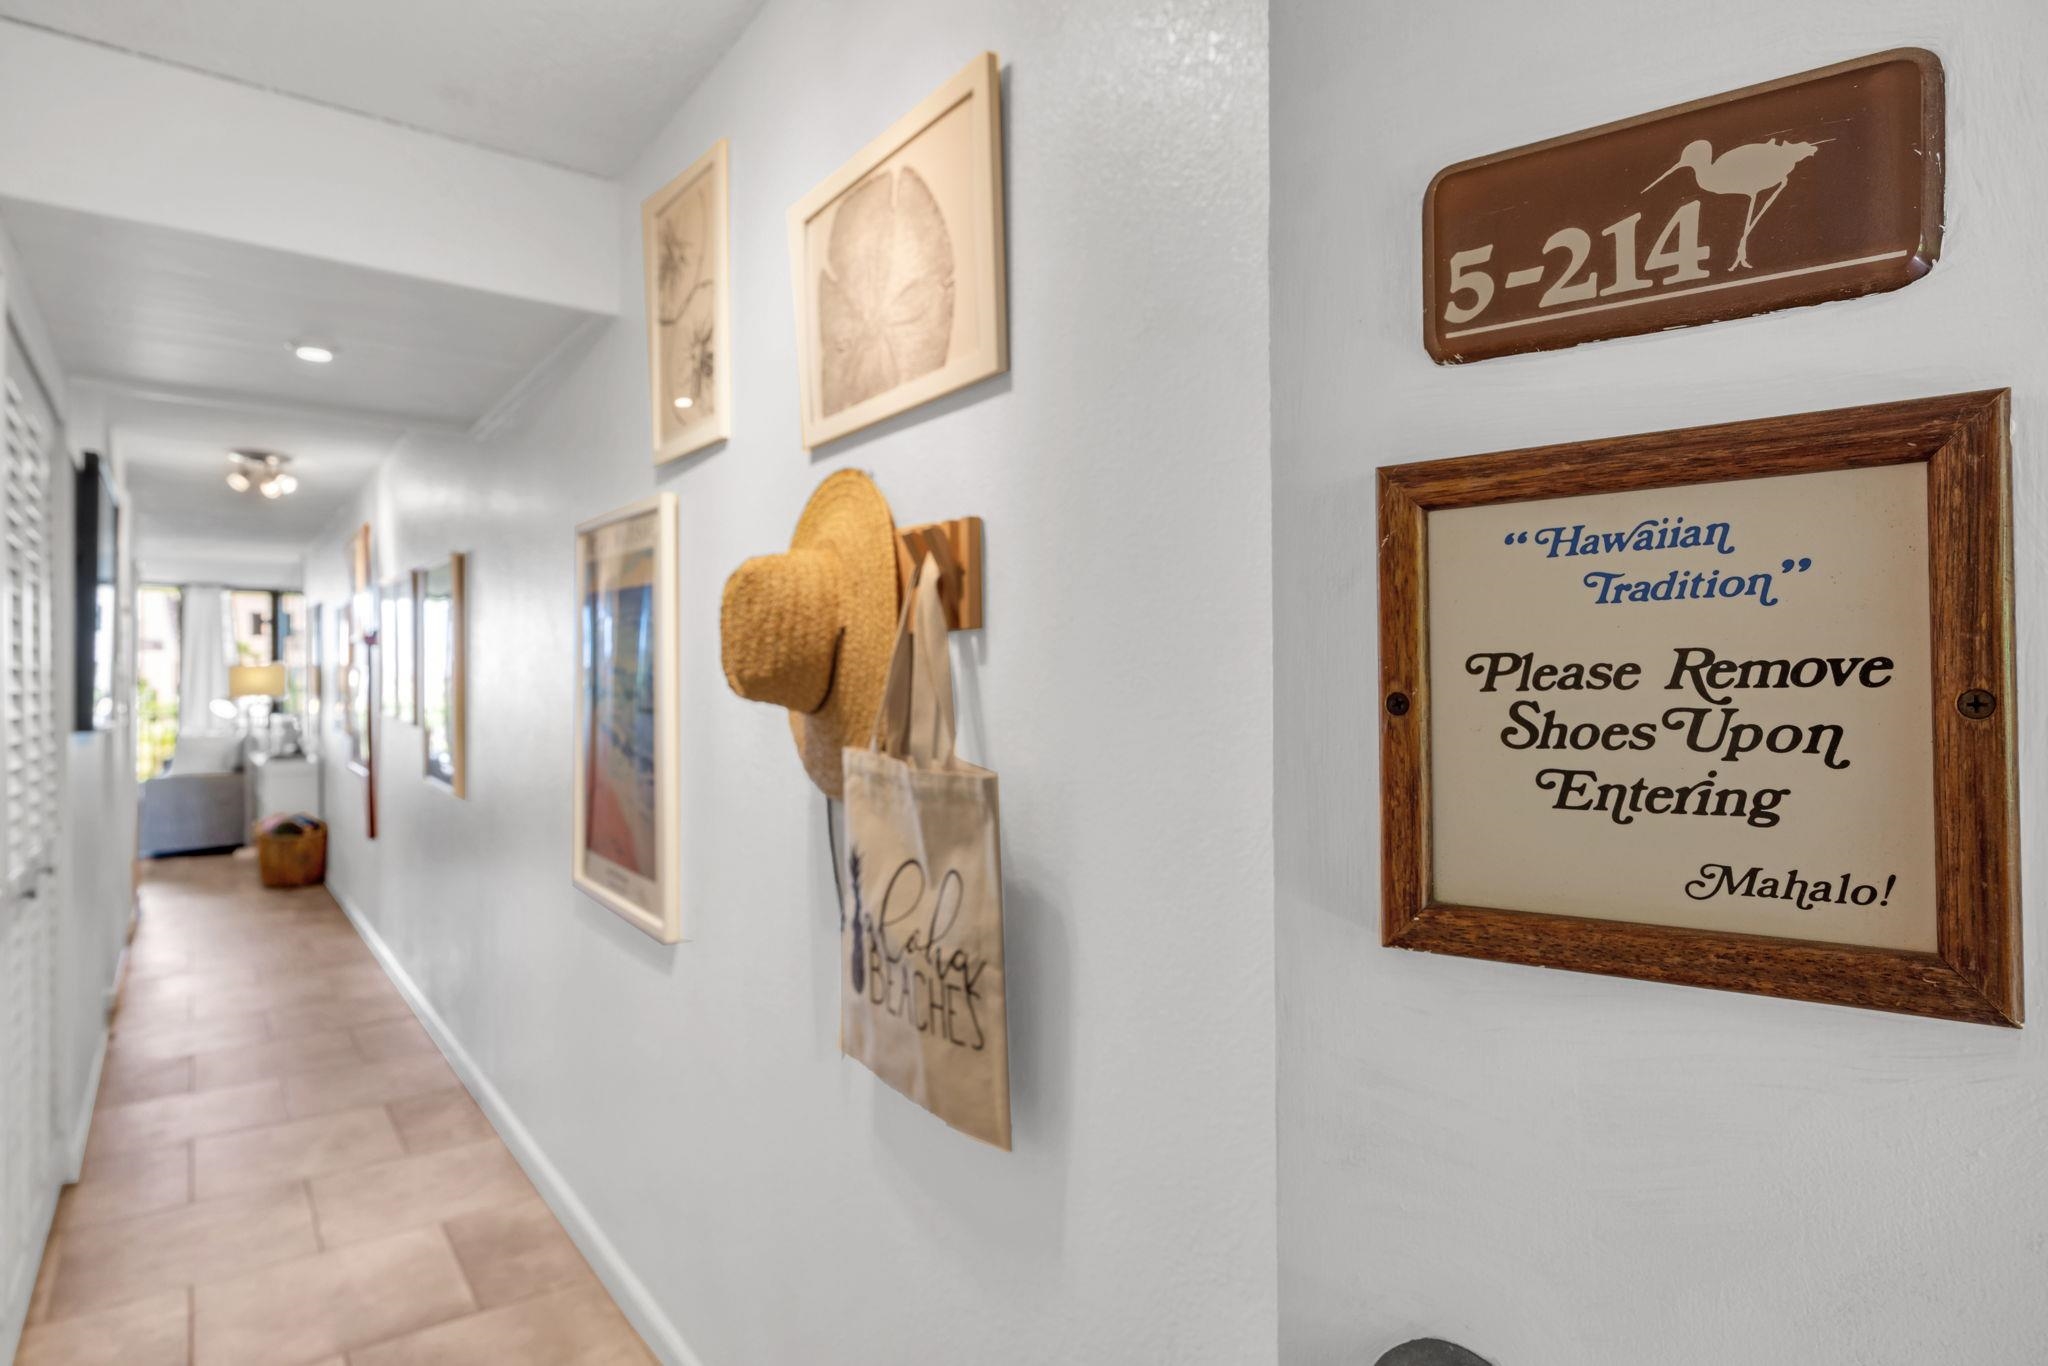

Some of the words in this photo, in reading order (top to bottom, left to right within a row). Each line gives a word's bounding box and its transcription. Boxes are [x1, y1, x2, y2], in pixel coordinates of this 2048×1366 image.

[1443, 200, 1710, 323] 5-214
[1465, 652, 1641, 692] Please
[1664, 648, 1894, 705] Remove
[1501, 700, 1656, 750] Shoes
[1662, 708, 1850, 769] Upon
[1536, 769, 1791, 828] Entering
[1685, 864, 1896, 910] Mahalo!
[869, 949, 985, 1051] BEACHES
